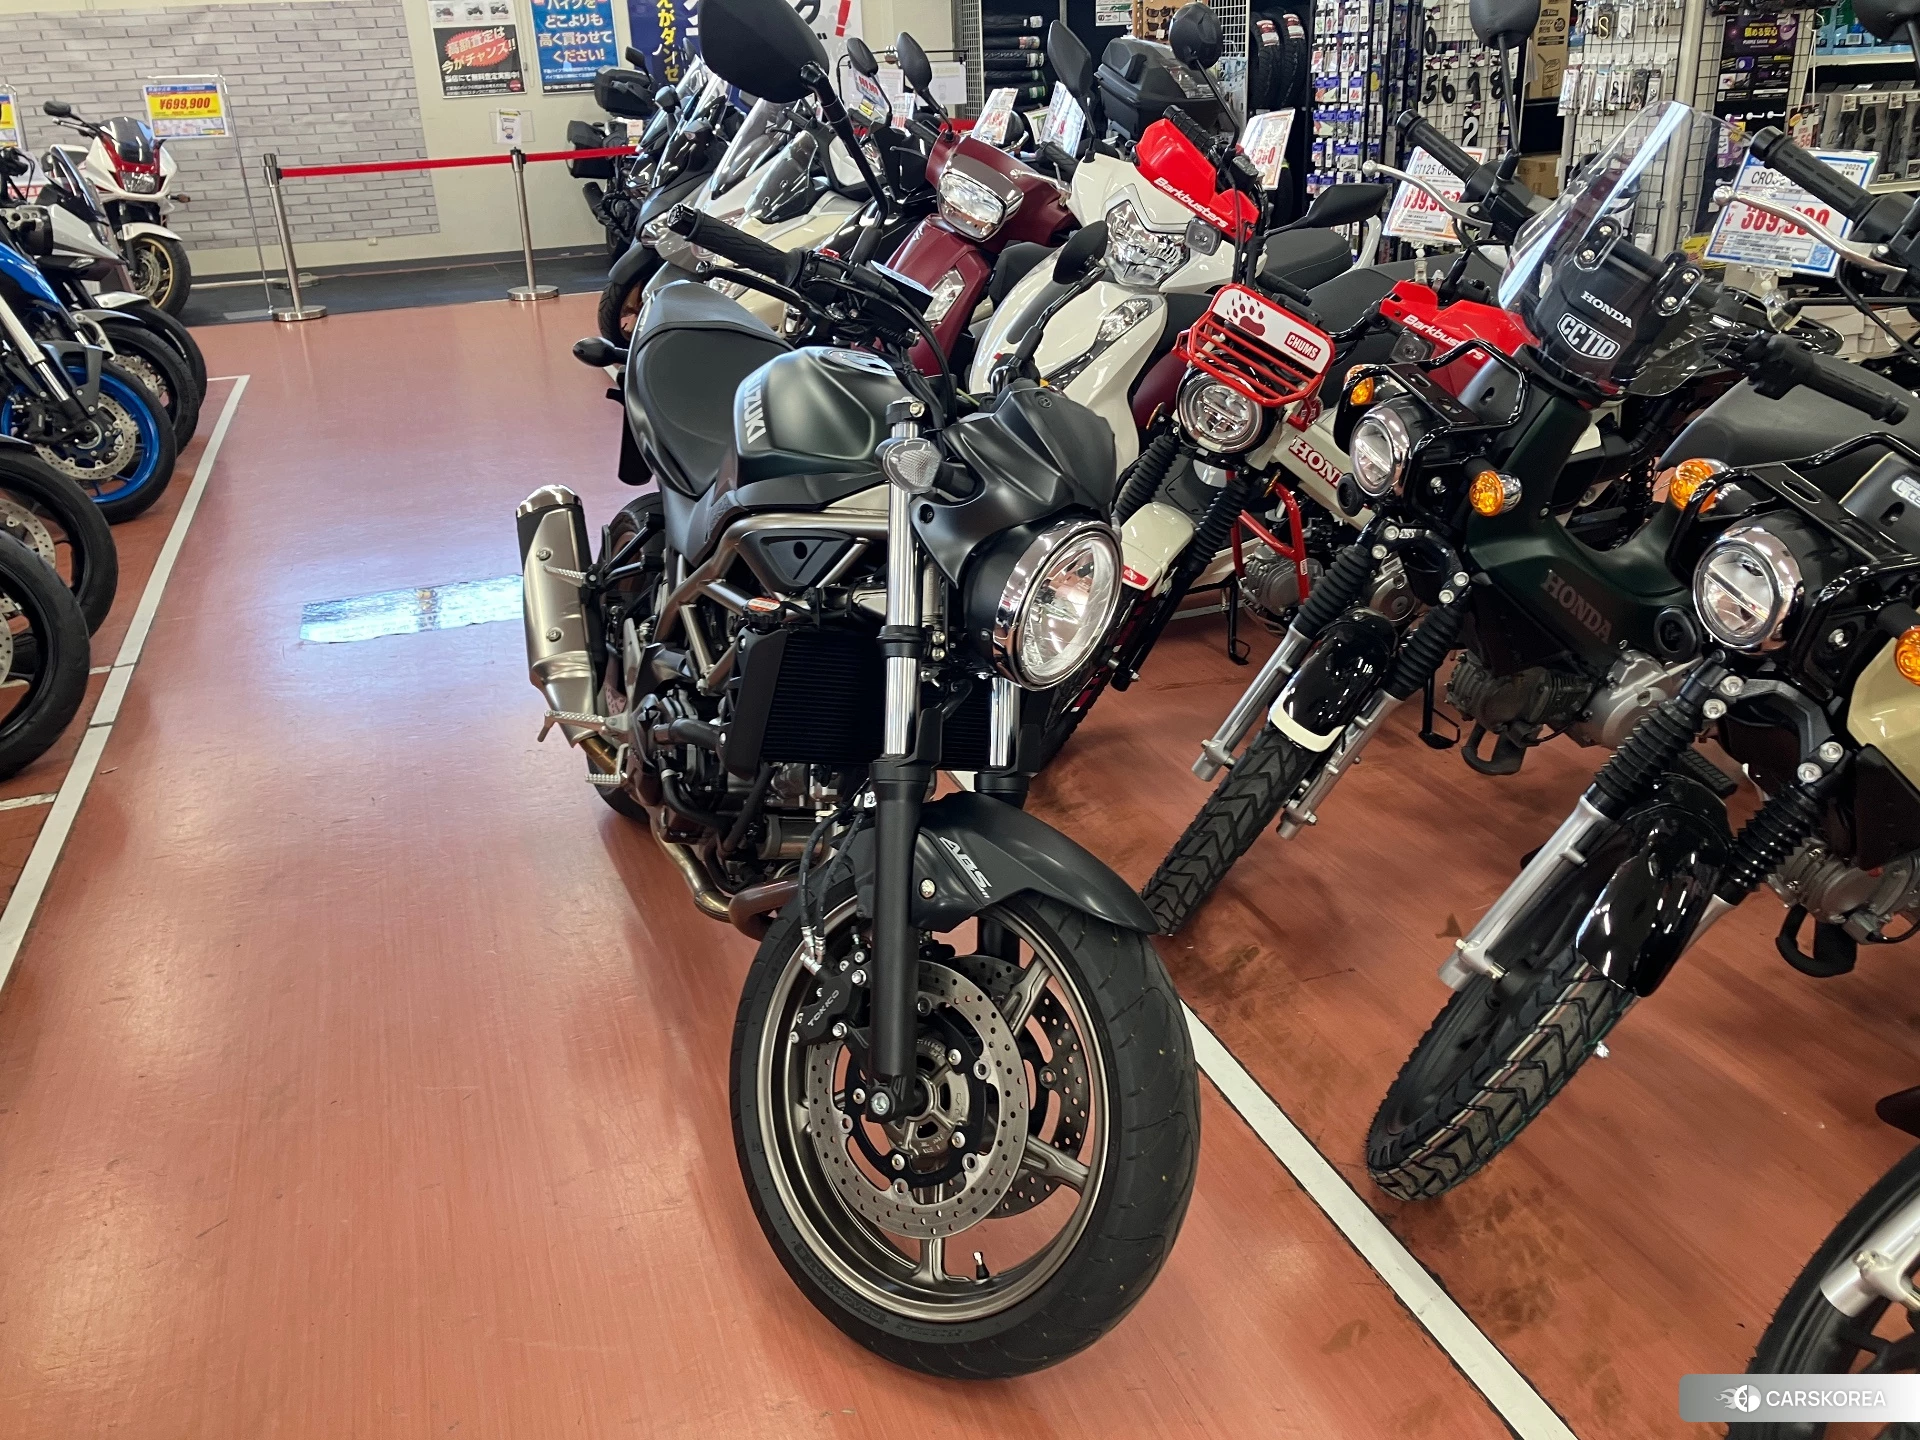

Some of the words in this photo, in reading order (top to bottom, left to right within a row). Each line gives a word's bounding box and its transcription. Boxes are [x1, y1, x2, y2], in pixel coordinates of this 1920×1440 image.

[545, 13, 603, 28] どこよりも
[446, 26, 506, 57] 高額査定は
[538, 31, 612, 47] 高く買わせて
[553, 48, 605, 63] ください!
[160, 97, 210, 109] ¥699,900
[1422, 74, 1438, 104] 5
[1441, 75, 1456, 104] 6
[1153, 176, 1229, 228] Barkbusters
[1581, 290, 1632, 328] HONDA
[1286, 334, 1318, 359] CHUMS
[1402, 314, 1486, 360] Barkbusrs
[1288, 435, 1344, 489] HON
[1540, 568, 1612, 644] HONDA
[939, 836, 992, 898] ABS
[808, 989, 839, 1026] TOKICO
